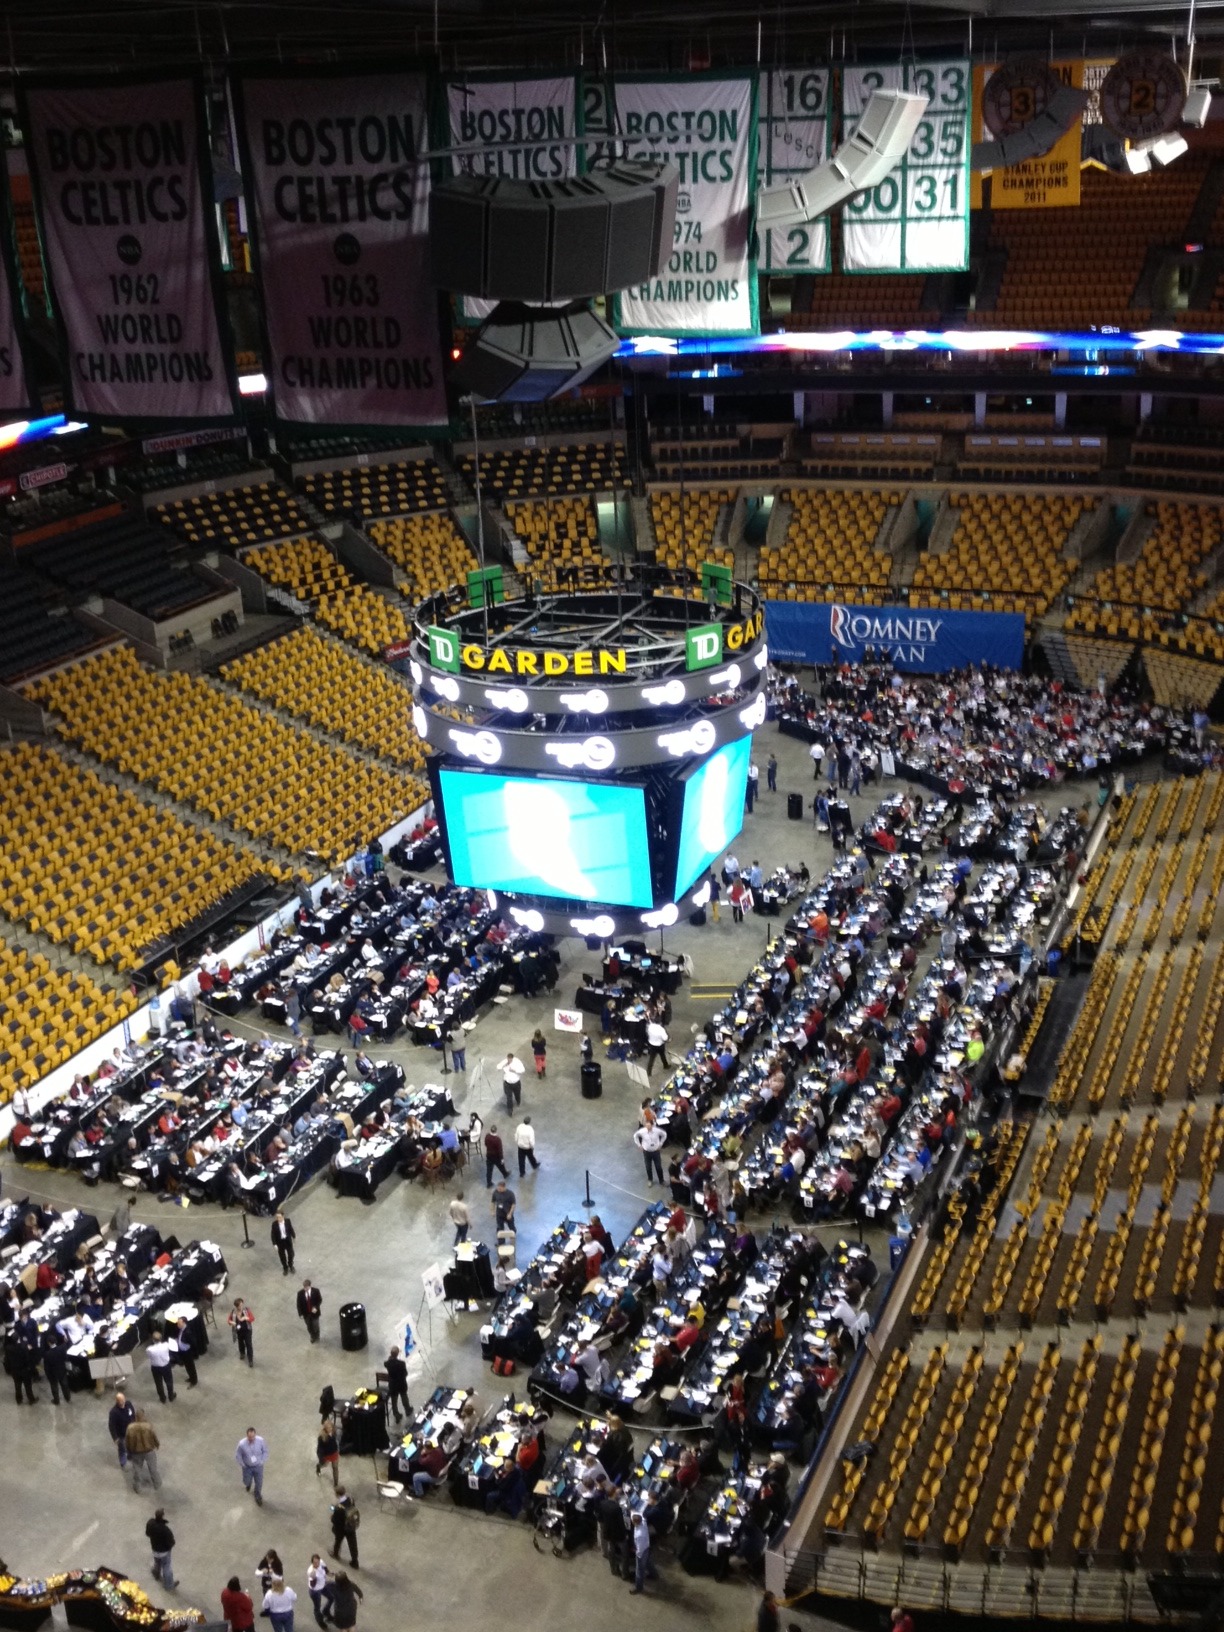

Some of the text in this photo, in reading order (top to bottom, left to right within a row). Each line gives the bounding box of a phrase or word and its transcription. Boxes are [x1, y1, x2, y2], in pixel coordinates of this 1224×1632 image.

[784, 74, 822, 112] 16
[915, 67, 965, 107] 33
[1014, 92, 1030, 114] 3
[1134, 85, 1150, 108] 2
[263, 114, 415, 166] BOSTON
[460, 106, 564, 143] BOSTON
[626, 109, 737, 144] BOSTON
[910, 121, 963, 160] 35
[46, 122, 186, 173] BOSTON
[1003, 176, 1068, 190] CHAMPIONS
[1004, 162, 1068, 176] STANLEY CUP
[60, 175, 188, 226] CELTICS
[274, 173, 413, 224] CELTICS
[915, 174, 958, 211] 31
[1024, 192, 1046, 203] 2011
[673, 222, 702, 244] 974
[787, 229, 810, 265] 2
[669, 251, 717, 273] ORLD
[109, 273, 160, 305] 1962
[321, 273, 380, 308] 1963
[628, 281, 739, 303] CHAMPIONS
[97, 314, 182, 345] WORLD
[308, 317, 401, 349] WORLD
[75, 351, 213, 384] CHAMPIONS
[281, 355, 434, 390] CHAMPIONS
[30, 466, 65, 484] CHIPOTLE
[830, 604, 943, 648] ROMNEY
[433, 636, 453, 661] TD
[462, 645, 626, 676] GARDEN
[692, 635, 720, 660] TD
